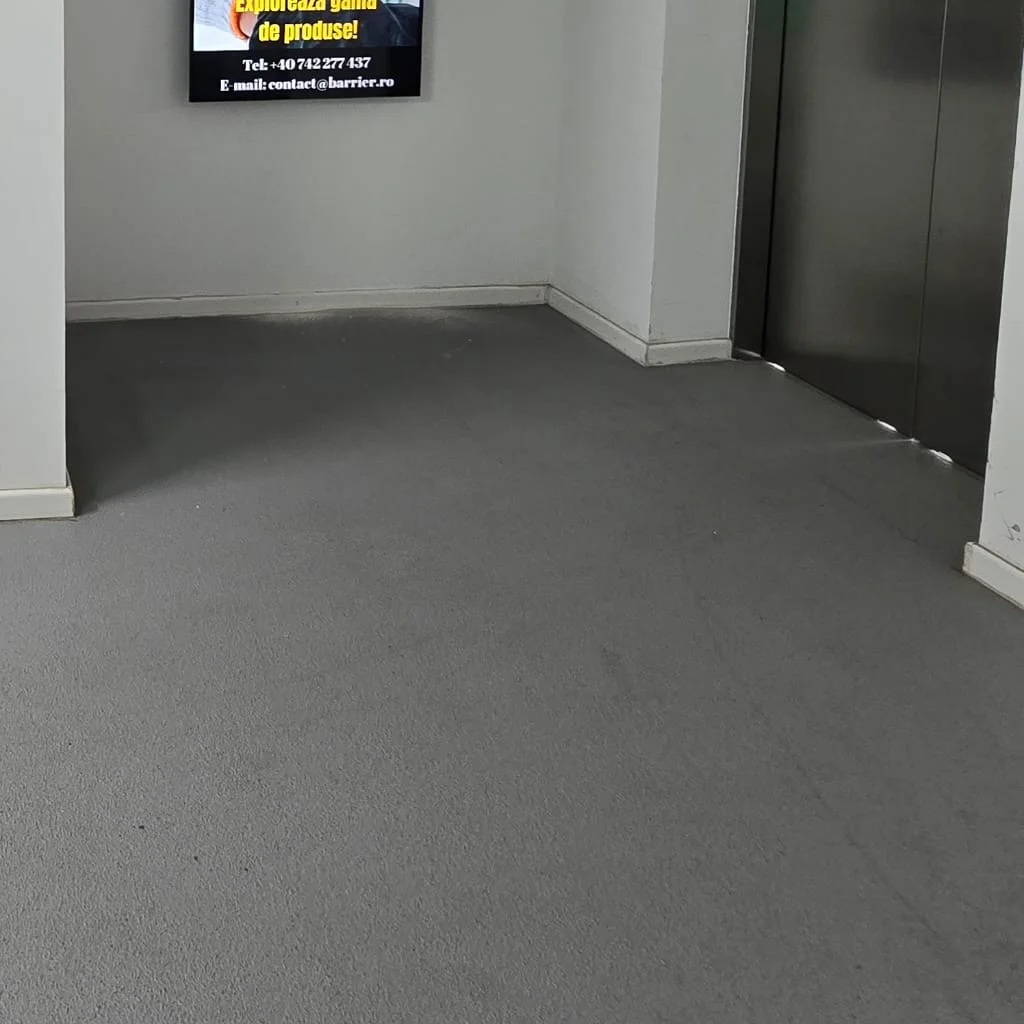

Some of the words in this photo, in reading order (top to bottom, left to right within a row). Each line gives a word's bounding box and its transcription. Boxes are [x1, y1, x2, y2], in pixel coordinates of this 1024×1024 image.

[258, 21, 281, 42] de
[284, 19, 359, 44] produse!
[270, 58, 296, 71] +40
[297, 57, 321, 70] 742
[322, 57, 346, 69] 277
[346, 56, 372, 69] 437
[268, 76, 395, 91] contact@barrier.ro
